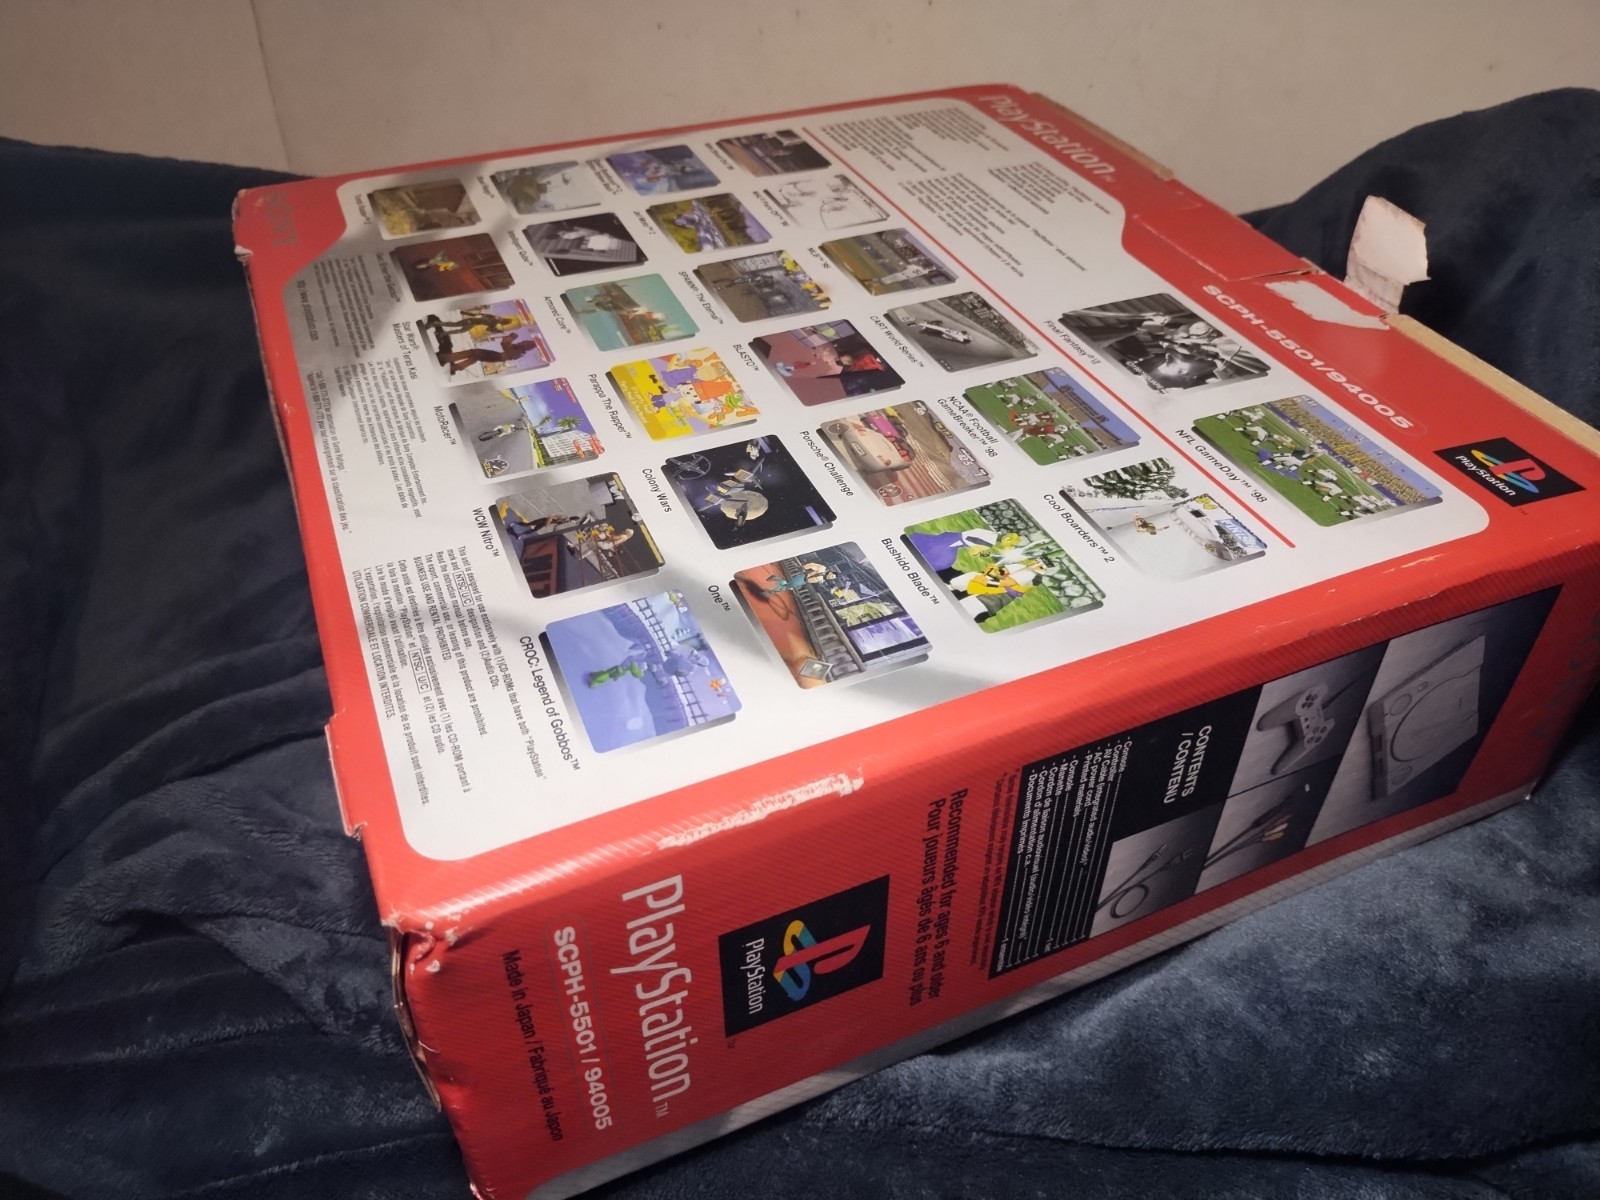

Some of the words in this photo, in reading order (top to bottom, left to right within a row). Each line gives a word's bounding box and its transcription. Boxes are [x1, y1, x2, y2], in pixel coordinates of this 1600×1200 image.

[543, 295, 561, 317] Armored
[391, 322, 405, 344] Masters
[401, 320, 412, 332] Star
[869, 315, 889, 330] CART
[884, 329, 903, 346] World
[1042, 320, 1064, 334] Final
[402, 350, 413, 367] Teras
[1202, 285, 1412, 428] SCPH-5501/94005
[407, 366, 418, 380] Kasi
[587, 373, 606, 398] Parappa
[601, 397, 613, 410] The
[968, 417, 999, 444] Football
[1174, 429, 1196, 445] NFL
[823, 461, 854, 496] Challenge
[1455, 455, 1516, 496] PlayStation
[641, 468, 661, 492] Colony
[656, 492, 672, 513] Wars
[1042, 493, 1066, 512] Cool
[472, 507, 489, 528] WCW
[424, 552, 433, 563] The
[457, 545, 467, 557] This
[880, 537, 910, 572] Bushido
[413, 555, 428, 582] BUSINESS
[450, 560, 461, 571] and
[420, 580, 432, 593] USE
[454, 573, 467, 591] NTSC
[464, 572, 481, 595] designed
[424, 592, 435, 605] AND
[432, 581, 450, 611] commercial
[471, 593, 483, 604] for
[476, 602, 487, 613] use
[428, 604, 441, 626] RENTAL
[466, 607, 482, 637] designation
[480, 613, 497, 643] exclusively
[448, 629, 460, 652] leasing
[476, 638, 488, 650] and
[491, 642, 502, 656] with
[456, 657, 467, 670] this
[458, 669, 474, 692] product
[519, 635, 540, 668] CROC:
[530, 668, 555, 706] Legend
[545, 706, 560, 717] of
[467, 692, 477, 703] are
[508, 691, 520, 705] that
[512, 704, 524, 720] have
[517, 720, 530, 736] both
[1092, 751, 1103, 764] AC
[1102, 748, 1112, 759] AV
[1107, 743, 1123, 781] Controller
[1117, 740, 1133, 773] Console
[1181, 725, 1212, 797] CONTENTS
[1054, 762, 1068, 796] Manette
[1064, 759, 1079, 791] Console
[1079, 753, 1093, 783] Printed
[1087, 764, 1098, 788] power
[1097, 759, 1111, 782] Cable
[1163, 739, 1191, 803] CONTENU
[1035, 769, 1048, 800] Cordon
[1045, 766, 1059, 797] Cordon
[1022, 773, 1038, 819] Documents
[1041, 797, 1052, 808] de
[1072, 783, 1085, 817] materials
[1083, 789, 1093, 807] cord
[925, 797, 947, 832] Pour
[940, 788, 968, 889] Recommended
[921, 832, 944, 885] joueurs
[915, 884, 939, 917] âgés
[938, 888, 957, 909] for
[916, 916, 935, 934] de
[934, 909, 951, 940] ages
[915, 932, 933, 944] 6
[933, 938, 951, 950] 6
[913, 944, 931, 967] ans
[930, 949, 947, 972] and
[500, 948, 525, 987] Made
[740, 937, 766, 1014] PlayStation
[910, 966, 926, 983] ou
[510, 986, 529, 1001] in
[908, 981, 928, 1007] plus
[927, 972, 945, 999] older
[514, 1003, 536, 1039] Japan
[553, 926, 596, 1054] SCPH-5501
[584, 1066, 612, 1130] 94005
[527, 1045, 555, 1095] Fabriqué
[540, 1095, 555, 1111] au
[543, 1110, 564, 1142] Japon
